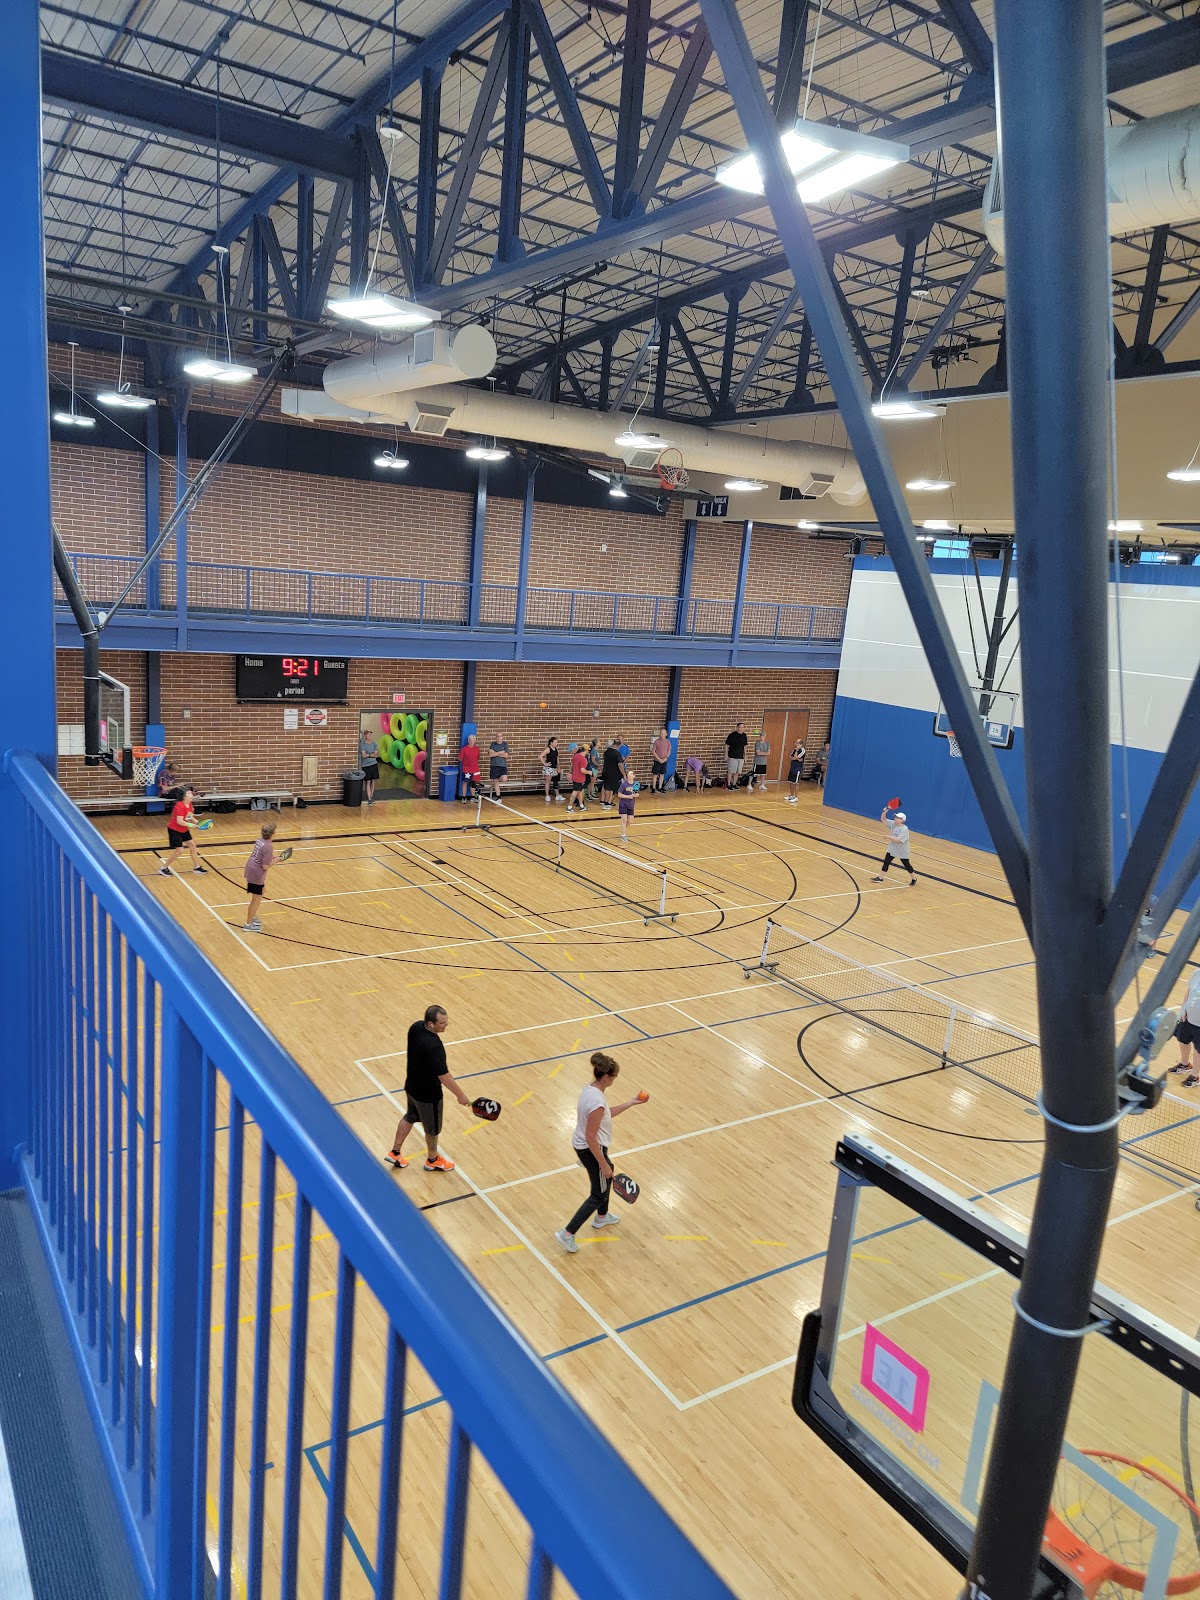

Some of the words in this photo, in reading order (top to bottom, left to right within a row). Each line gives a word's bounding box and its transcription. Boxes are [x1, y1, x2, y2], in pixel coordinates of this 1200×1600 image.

[245, 658, 264, 667] Home
[282, 658, 319, 676] 9:21
[324, 660, 345, 669] Guests
[284, 687, 304, 695] period
